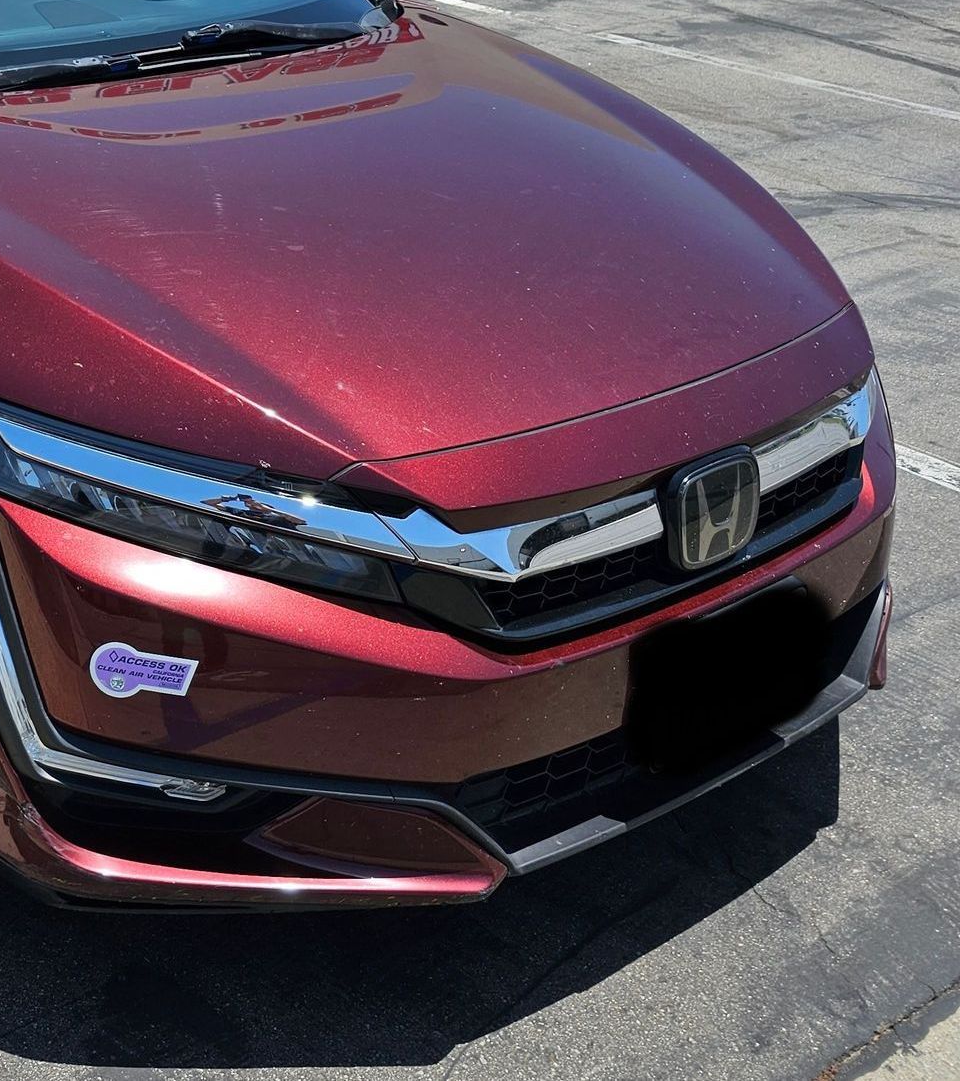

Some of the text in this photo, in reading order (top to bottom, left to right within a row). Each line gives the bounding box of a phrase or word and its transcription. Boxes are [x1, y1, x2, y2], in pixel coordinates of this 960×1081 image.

[118, 656, 188, 673] ACCESS OK
[97, 664, 127, 675] CLEAN
[147, 673, 183, 684] VEHICLE
[152, 669, 184, 678] CALIFORNIA
